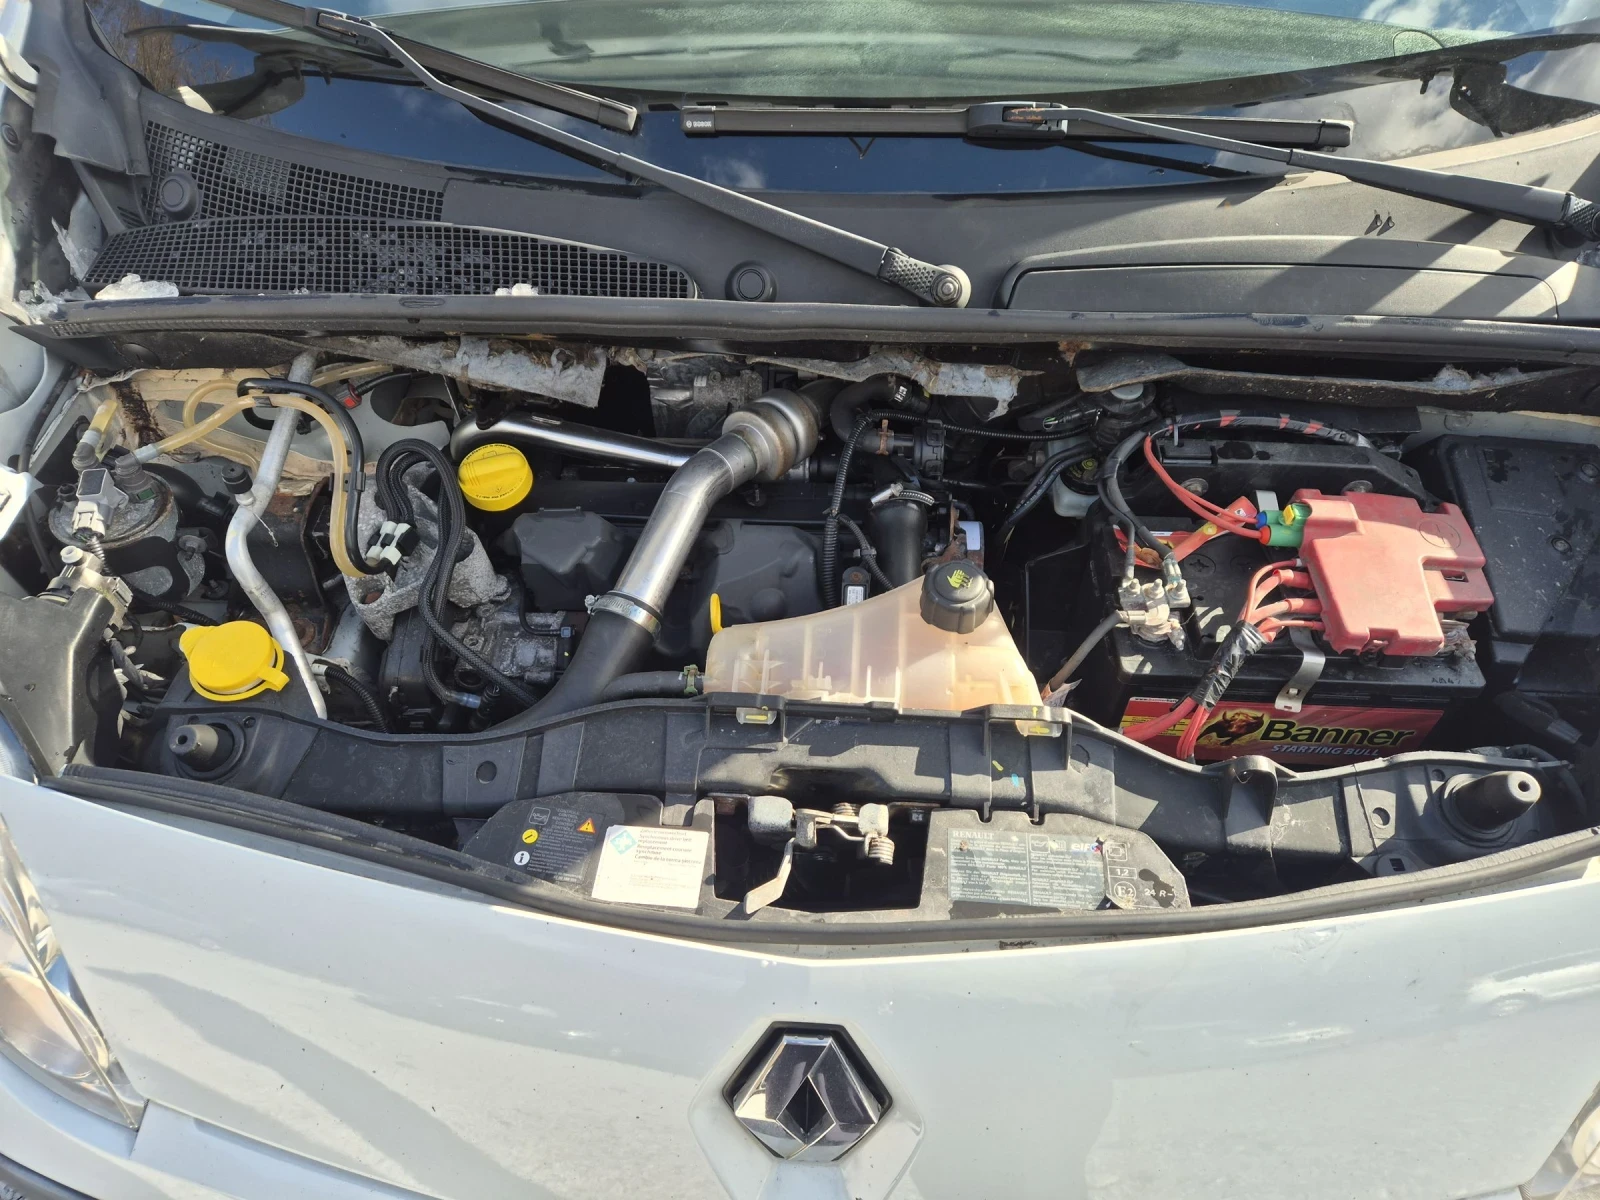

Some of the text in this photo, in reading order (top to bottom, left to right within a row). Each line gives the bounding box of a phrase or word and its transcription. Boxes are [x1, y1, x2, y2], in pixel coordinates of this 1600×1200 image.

[1260, 719, 1416, 746] Banner
[1271, 744, 1380, 757] STARTING BULL
[952, 830, 994, 840] RENAULT
